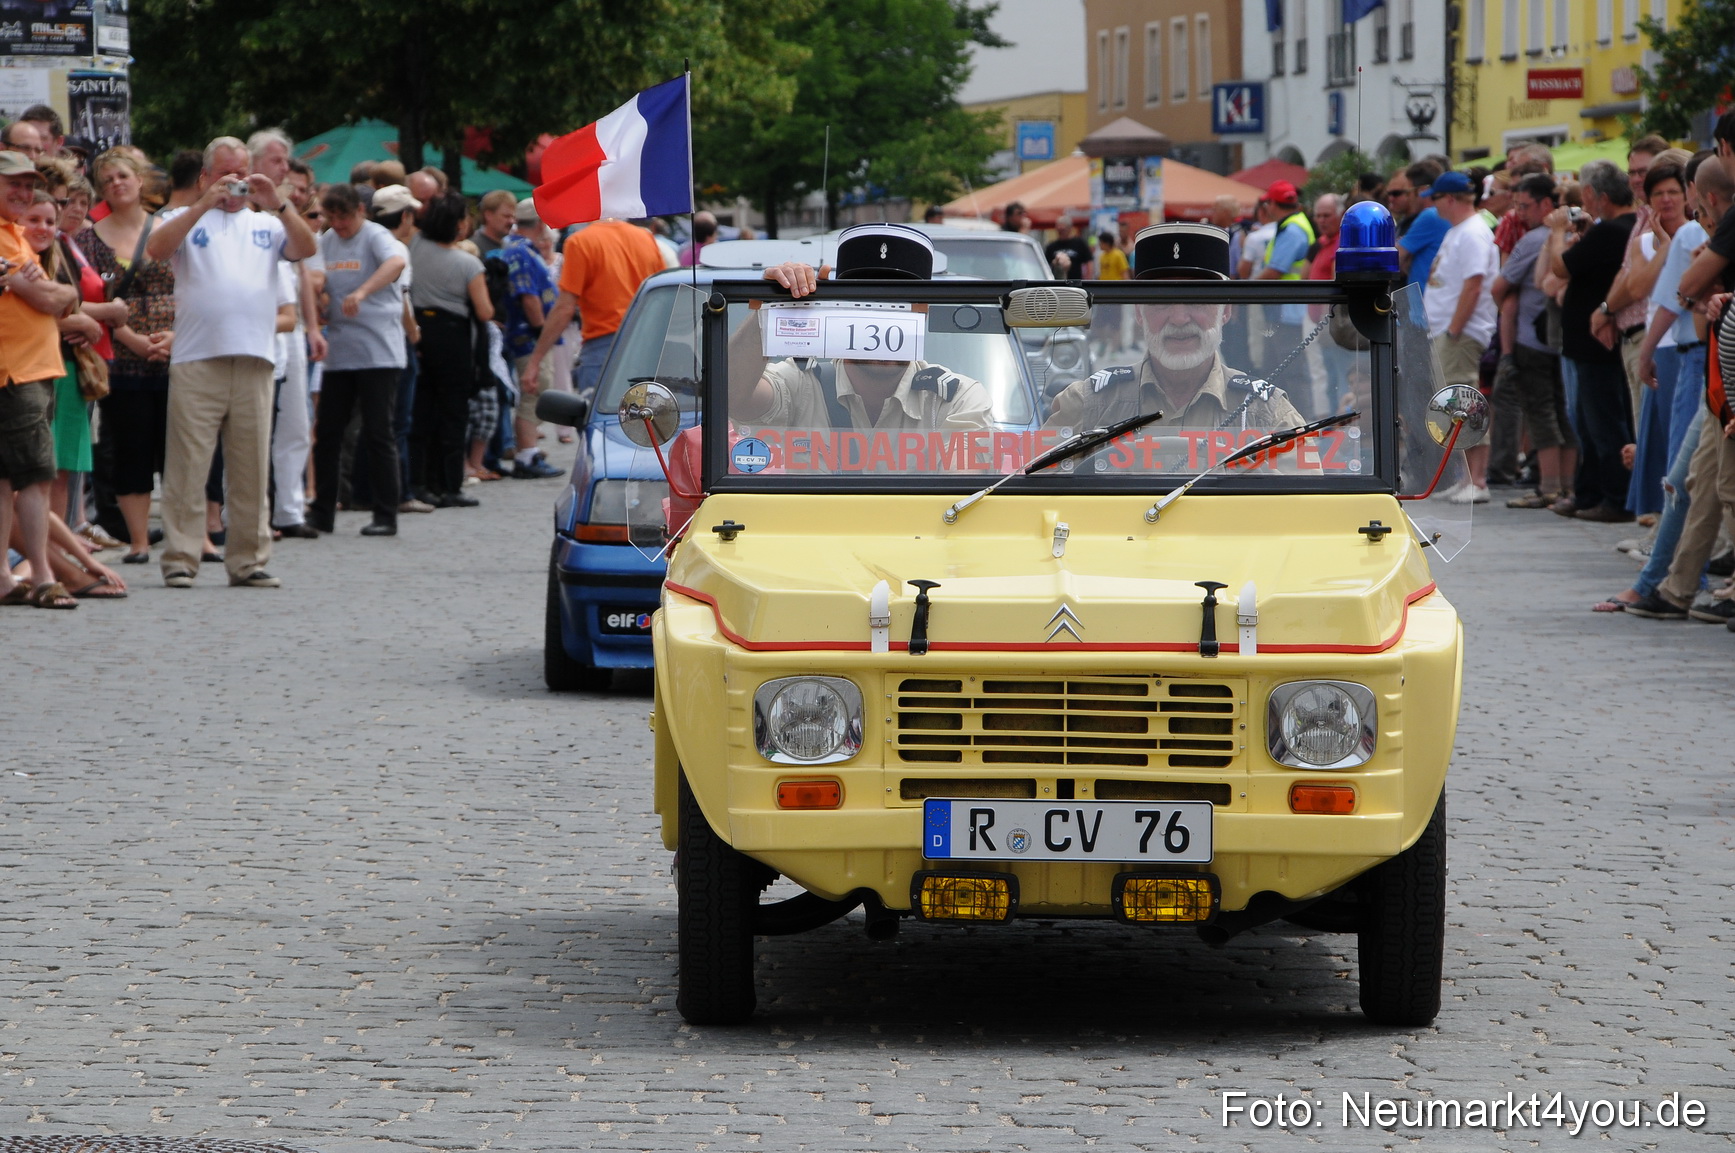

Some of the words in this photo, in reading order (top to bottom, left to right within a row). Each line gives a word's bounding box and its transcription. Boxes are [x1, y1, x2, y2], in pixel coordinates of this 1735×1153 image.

[846, 323, 904, 352] 130
[746, 442, 754, 455] 1
[607, 613, 635, 628] elf
[969, 807, 997, 851] R
[1044, 808, 1103, 852] CV
[1134, 809, 1190, 854] 76
[933, 834, 943, 847] D
